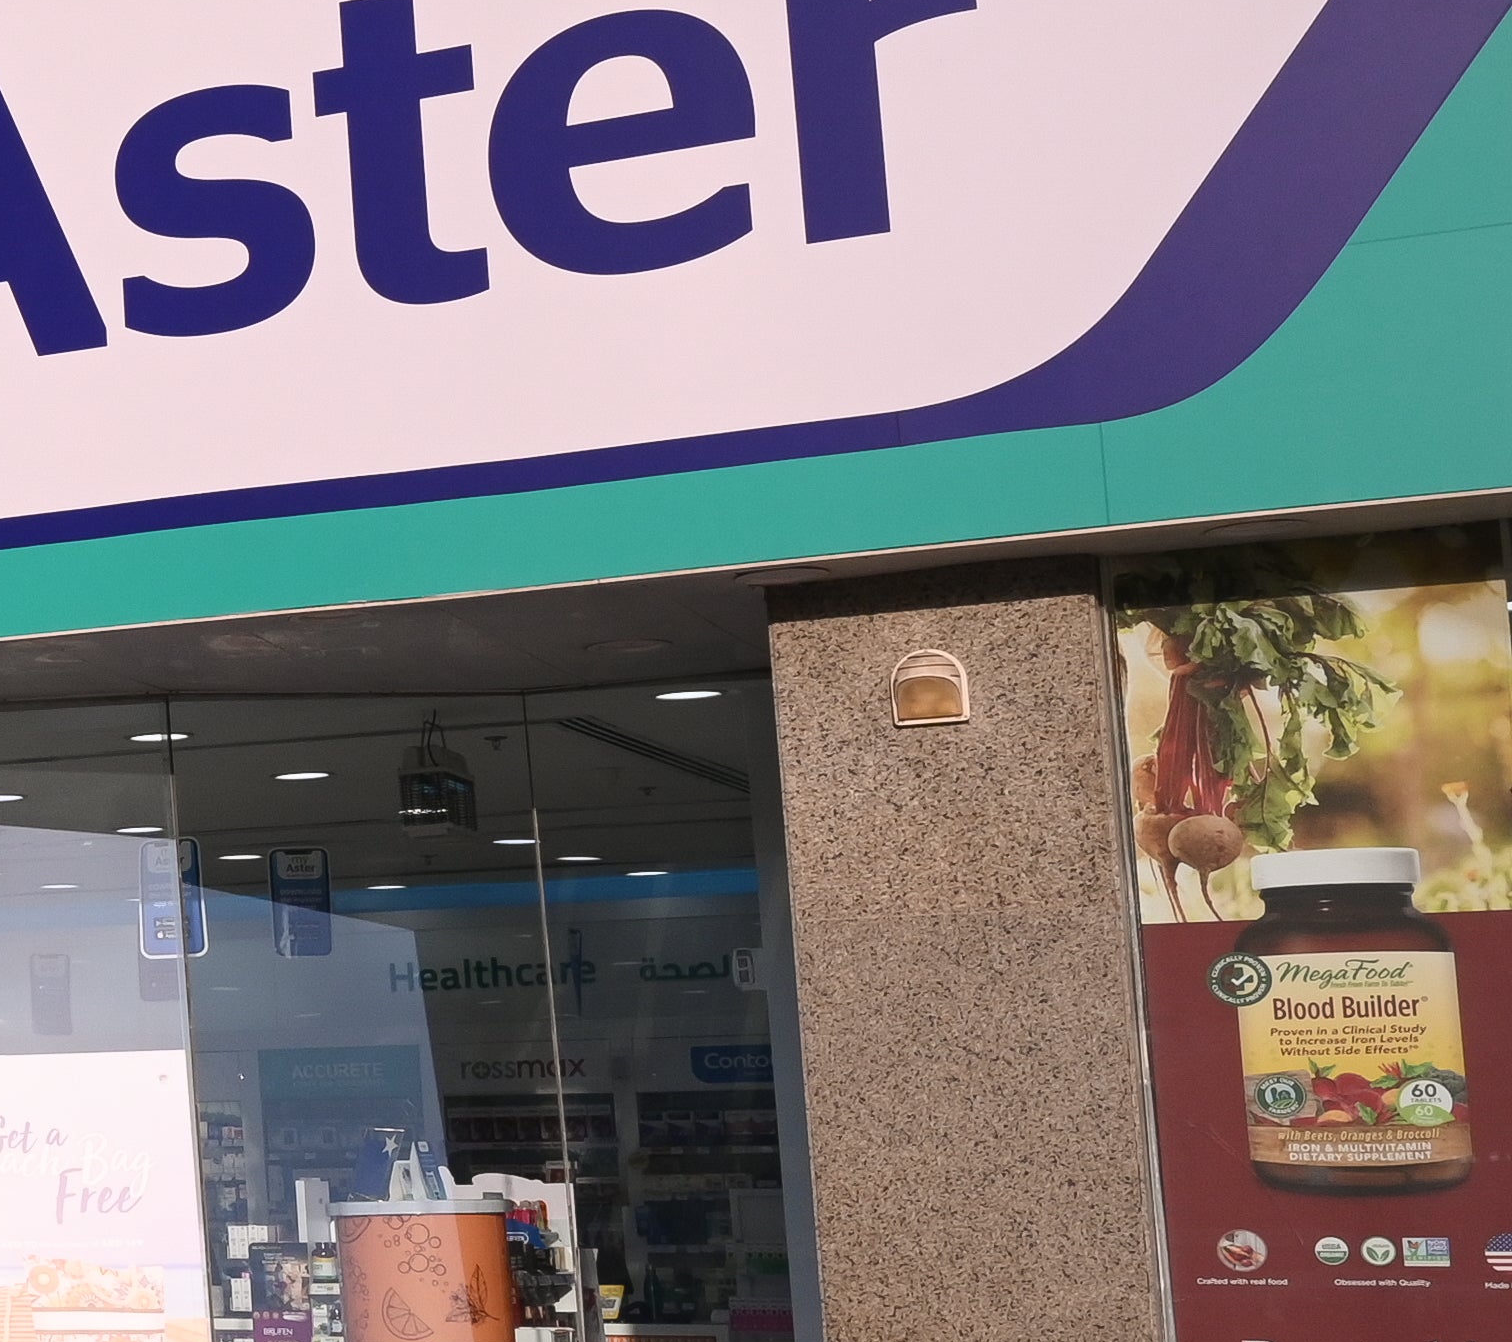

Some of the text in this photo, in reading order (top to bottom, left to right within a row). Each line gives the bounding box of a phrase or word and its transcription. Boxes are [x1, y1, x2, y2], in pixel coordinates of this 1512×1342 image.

[285, 863, 320, 872] Aster
[389, 956, 596, 993] Healthcare
[1273, 996, 1335, 1021] Blood
[1270, 1024, 1427, 1037] Proven in Clinical Study
[1279, 1034, 1419, 1045] to Increase Iron Levels
[1280, 1045, 1361, 1056] Without Side
[460, 1058, 586, 1078] rossmax
[1411, 1083, 1437, 1098] 60
[45, 1127, 68, 1147] a
[1288, 1141, 1432, 1152] IRON MULTIVITAMIN
[1289, 1150, 1433, 1162] DIETARY SUPPLEMENT
[80, 1132, 153, 1199] Bag
[55, 1167, 143, 1225] Free
[1196, 1277, 1228, 1286] Crafted
[1230, 1277, 1248, 1285] with
[1268, 1278, 1288, 1286] food
[1334, 1279, 1431, 1288] Obsessed with Quality
[1485, 1282, 1510, 1290] Made
